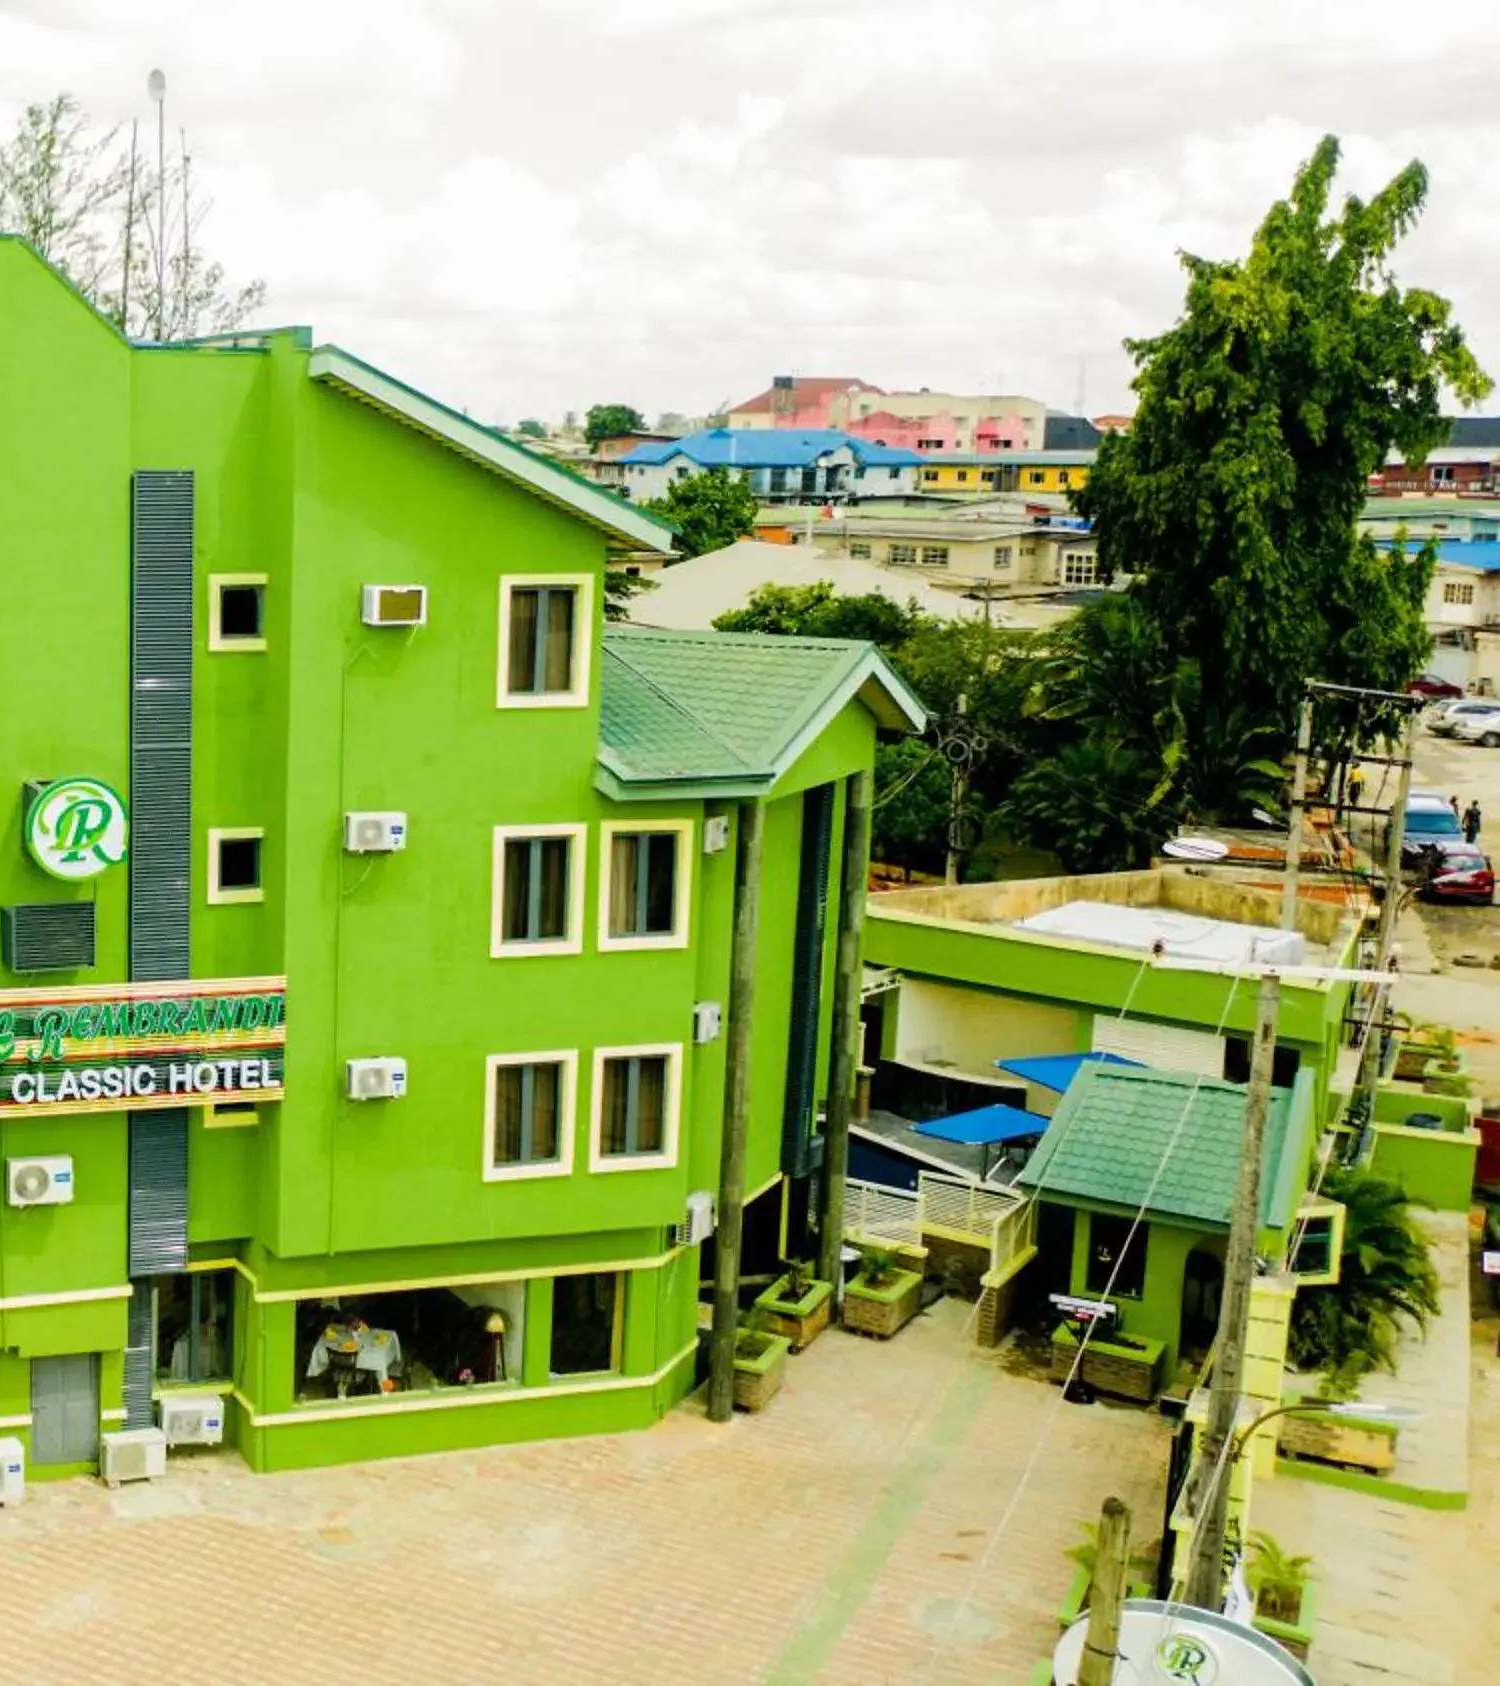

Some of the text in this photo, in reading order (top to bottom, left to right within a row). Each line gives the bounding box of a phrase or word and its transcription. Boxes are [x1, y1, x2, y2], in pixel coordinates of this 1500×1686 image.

[27, 993, 284, 1062] REMBRANDT
[11, 1058, 281, 1104] CLASSIC HOTEL
